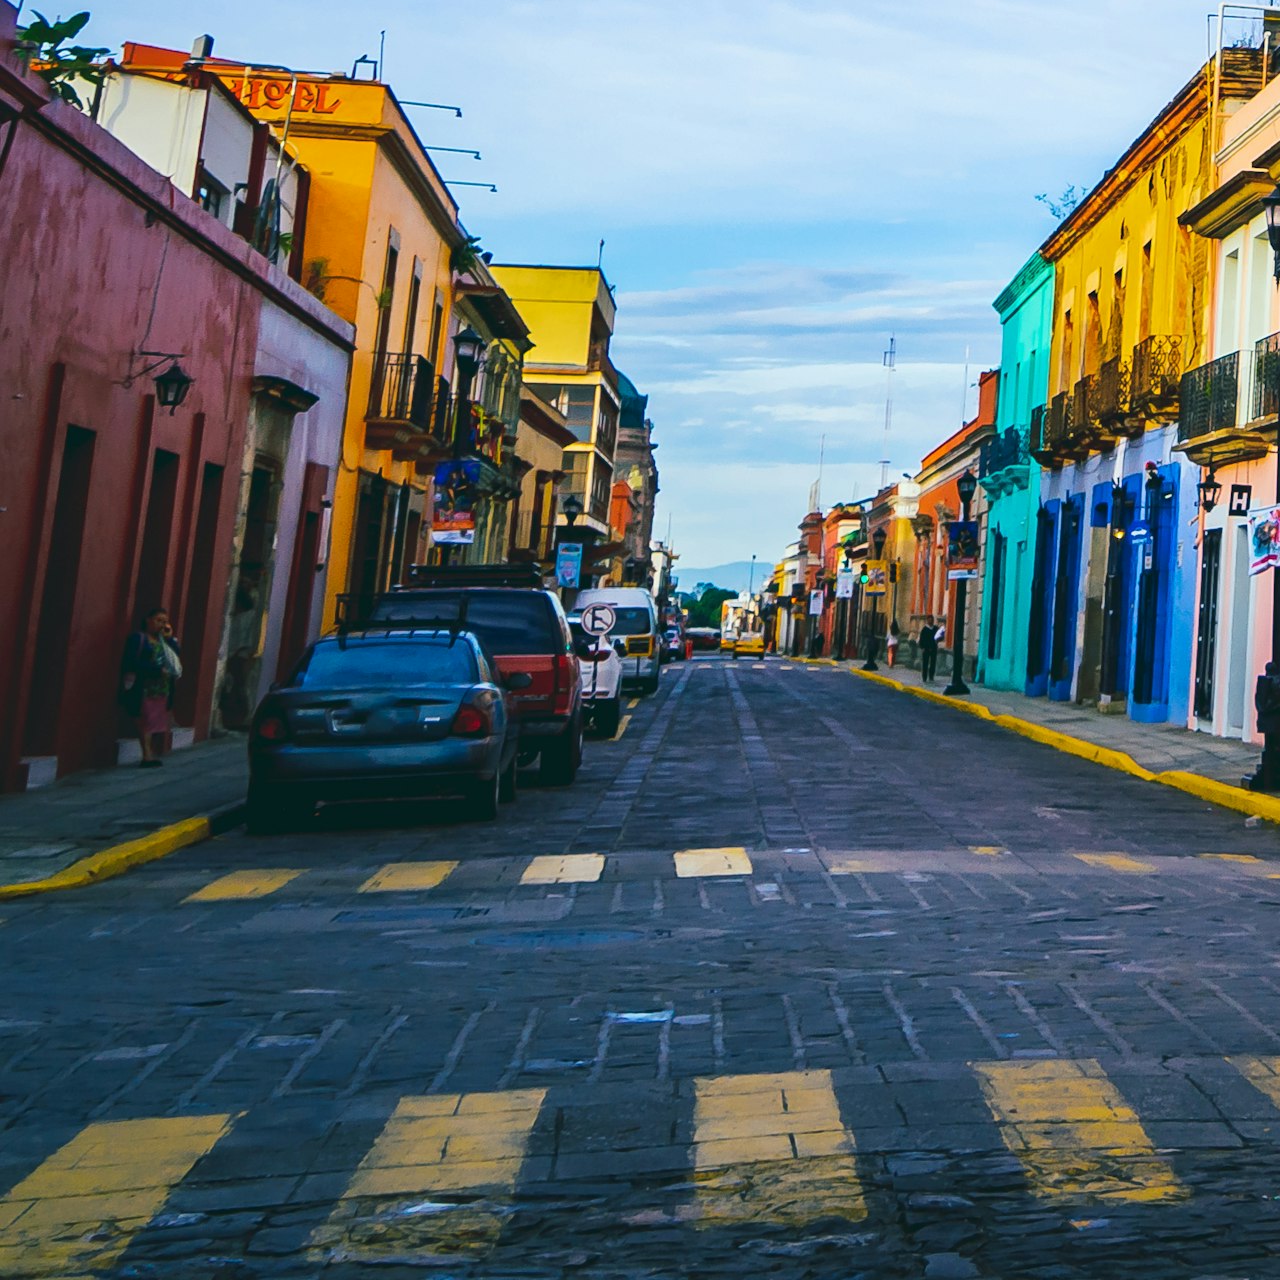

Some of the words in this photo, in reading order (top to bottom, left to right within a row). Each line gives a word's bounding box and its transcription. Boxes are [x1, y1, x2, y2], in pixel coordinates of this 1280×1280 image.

[231, 79, 342, 115] HOTEL
[1232, 491, 1248, 511] H
[591, 607, 607, 632] E
